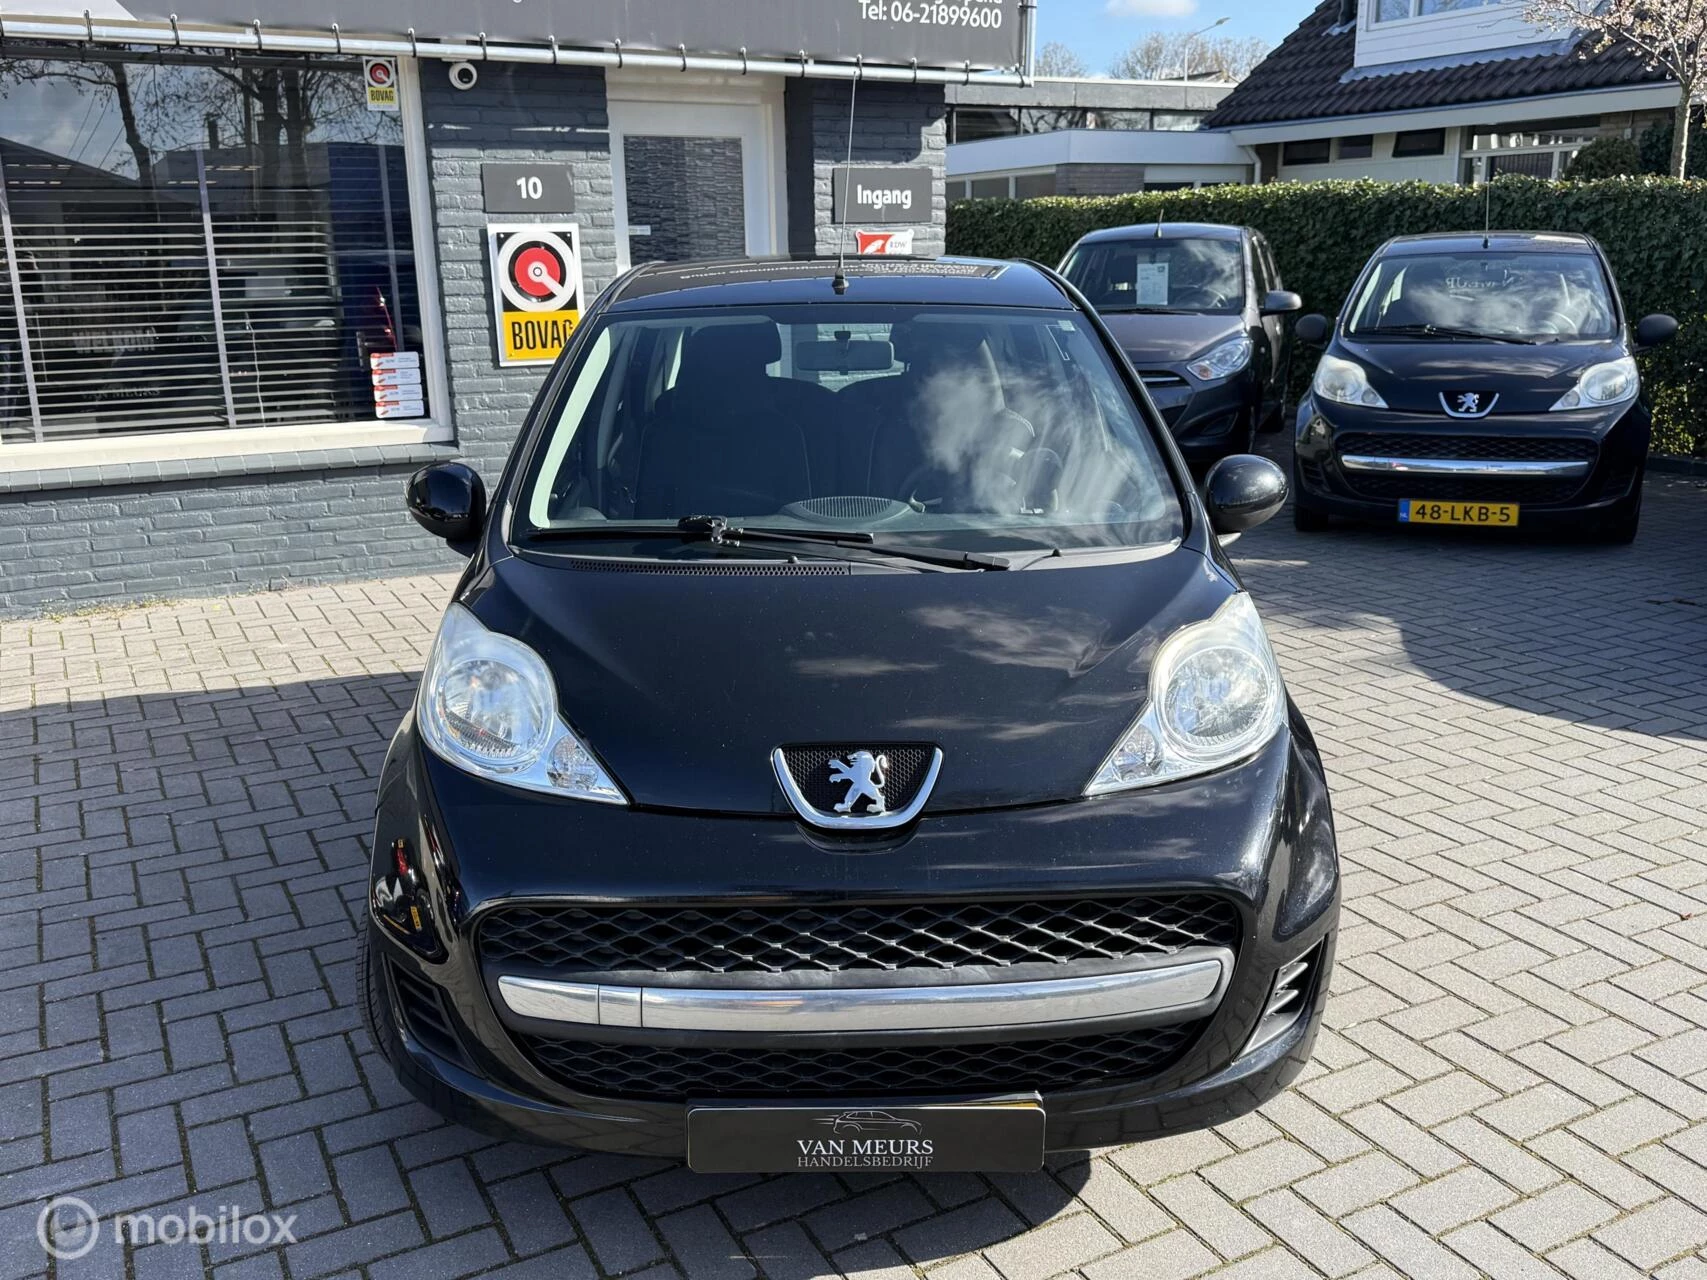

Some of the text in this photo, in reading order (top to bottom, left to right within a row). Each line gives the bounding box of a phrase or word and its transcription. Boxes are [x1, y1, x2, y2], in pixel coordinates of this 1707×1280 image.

[858, 0, 1002, 28] Tel: 06-21899600
[370, 90, 394, 101] BOVAG
[516, 176, 543, 199] 10
[857, 184, 912, 209] Ingang
[1415, 504, 1511, 522] 48-LKB-5
[797, 1139, 933, 1155] VAN MEURS
[797, 1156, 933, 1169] HANDELSBEDRIJF
